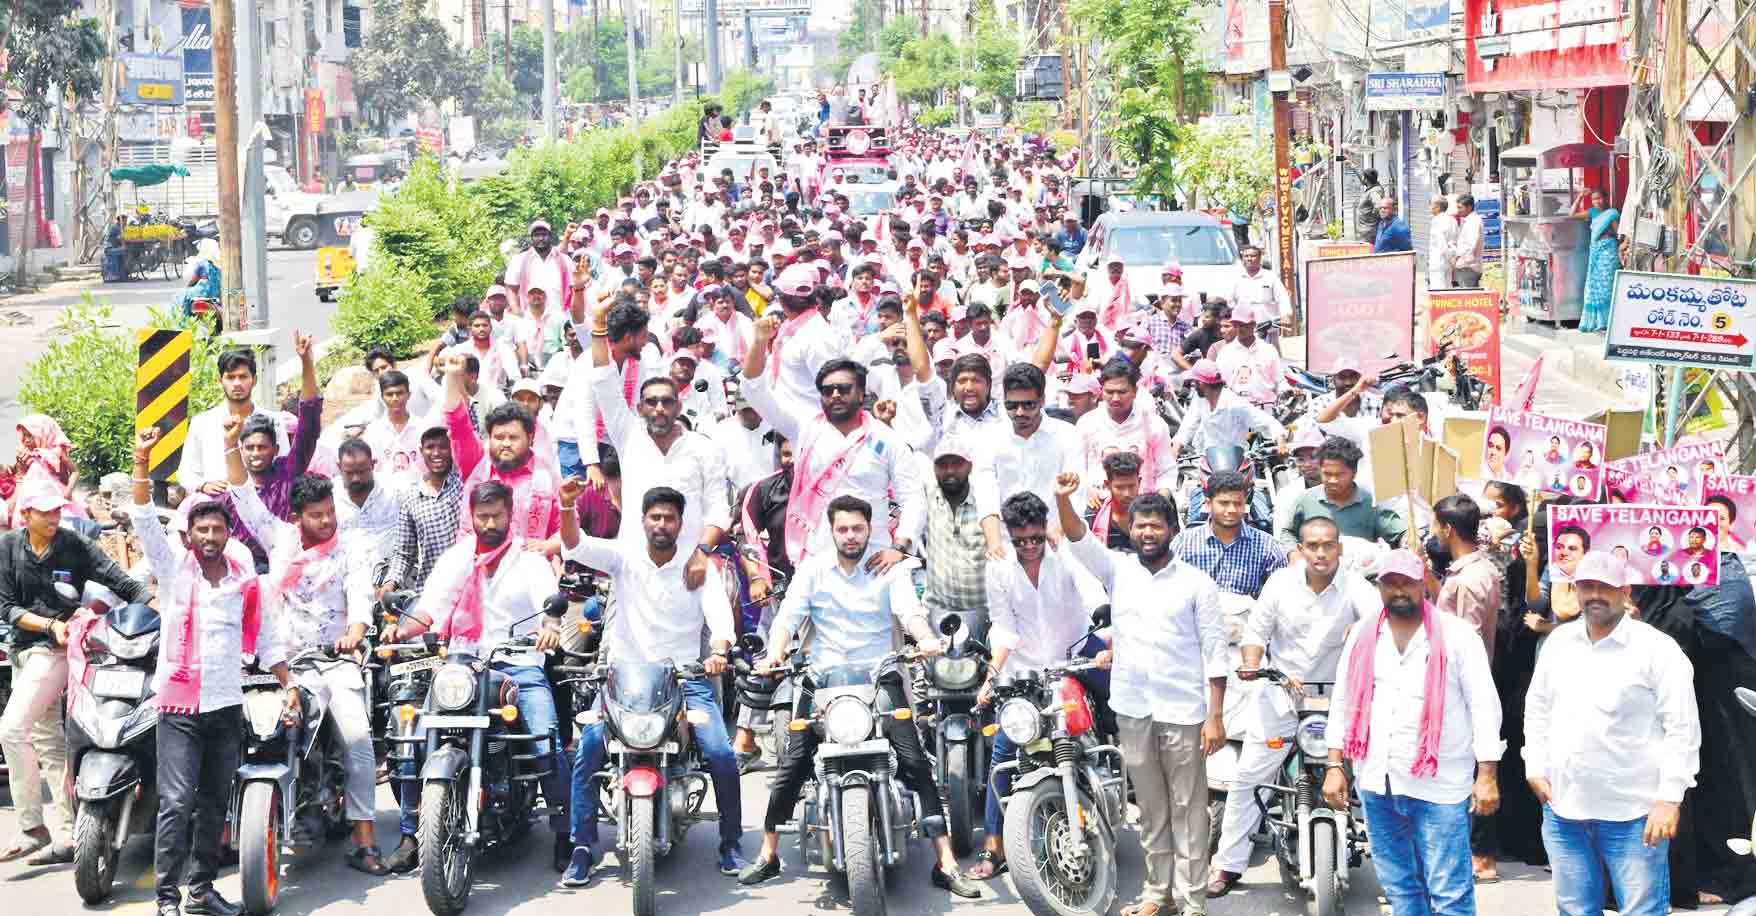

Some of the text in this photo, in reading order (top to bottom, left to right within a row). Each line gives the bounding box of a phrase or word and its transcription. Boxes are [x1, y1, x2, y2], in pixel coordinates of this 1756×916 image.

[1386, 77, 1441, 89] SHARADHA
[1464, 296, 1494, 308] HOTEL
[1715, 316, 1727, 329] 5
[1494, 406, 1604, 442] SAVE TELANGANA
[1706, 476, 1748, 493] SAVE
[1557, 506, 1717, 526] SAVE TELANGANA
